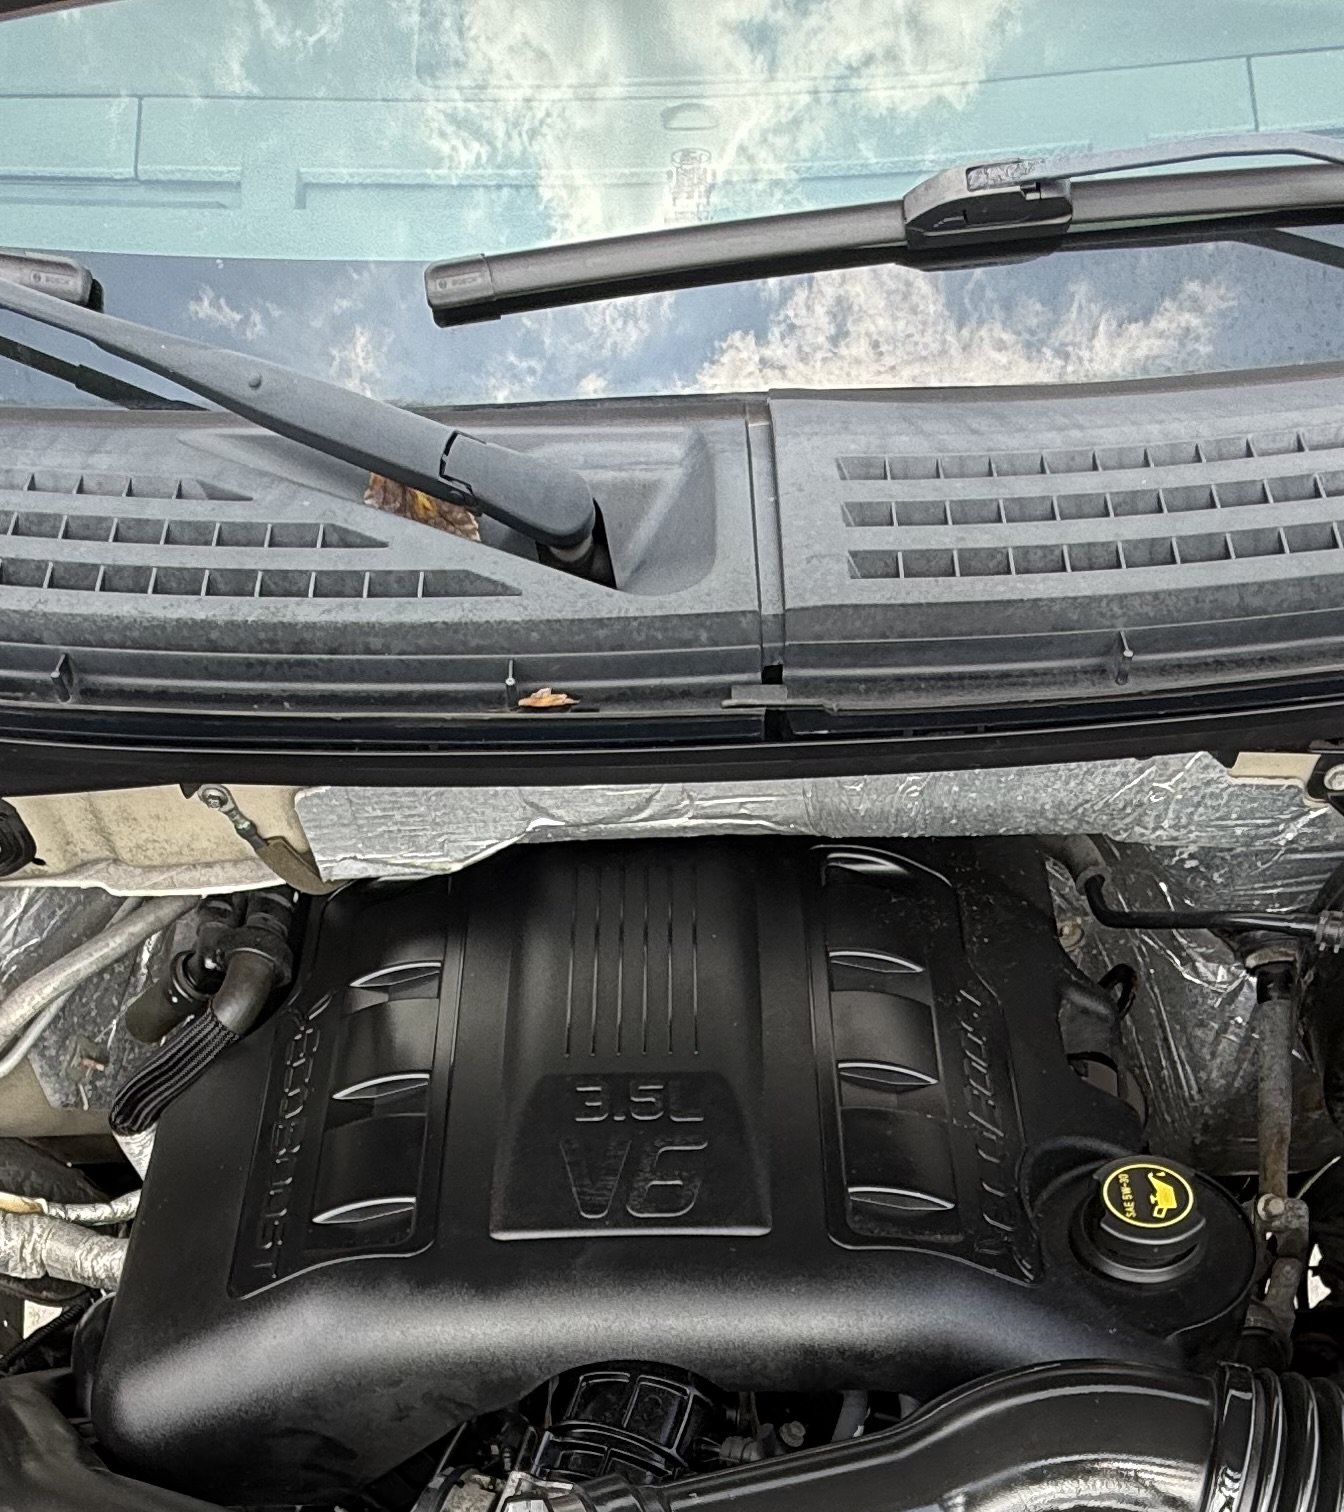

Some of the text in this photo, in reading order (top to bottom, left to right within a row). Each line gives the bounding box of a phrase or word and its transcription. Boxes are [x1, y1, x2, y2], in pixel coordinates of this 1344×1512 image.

[575, 1083, 704, 1122] 3.5L
[559, 1137, 708, 1219] V6
[1117, 1173, 1136, 1218] SAE 5W-30
